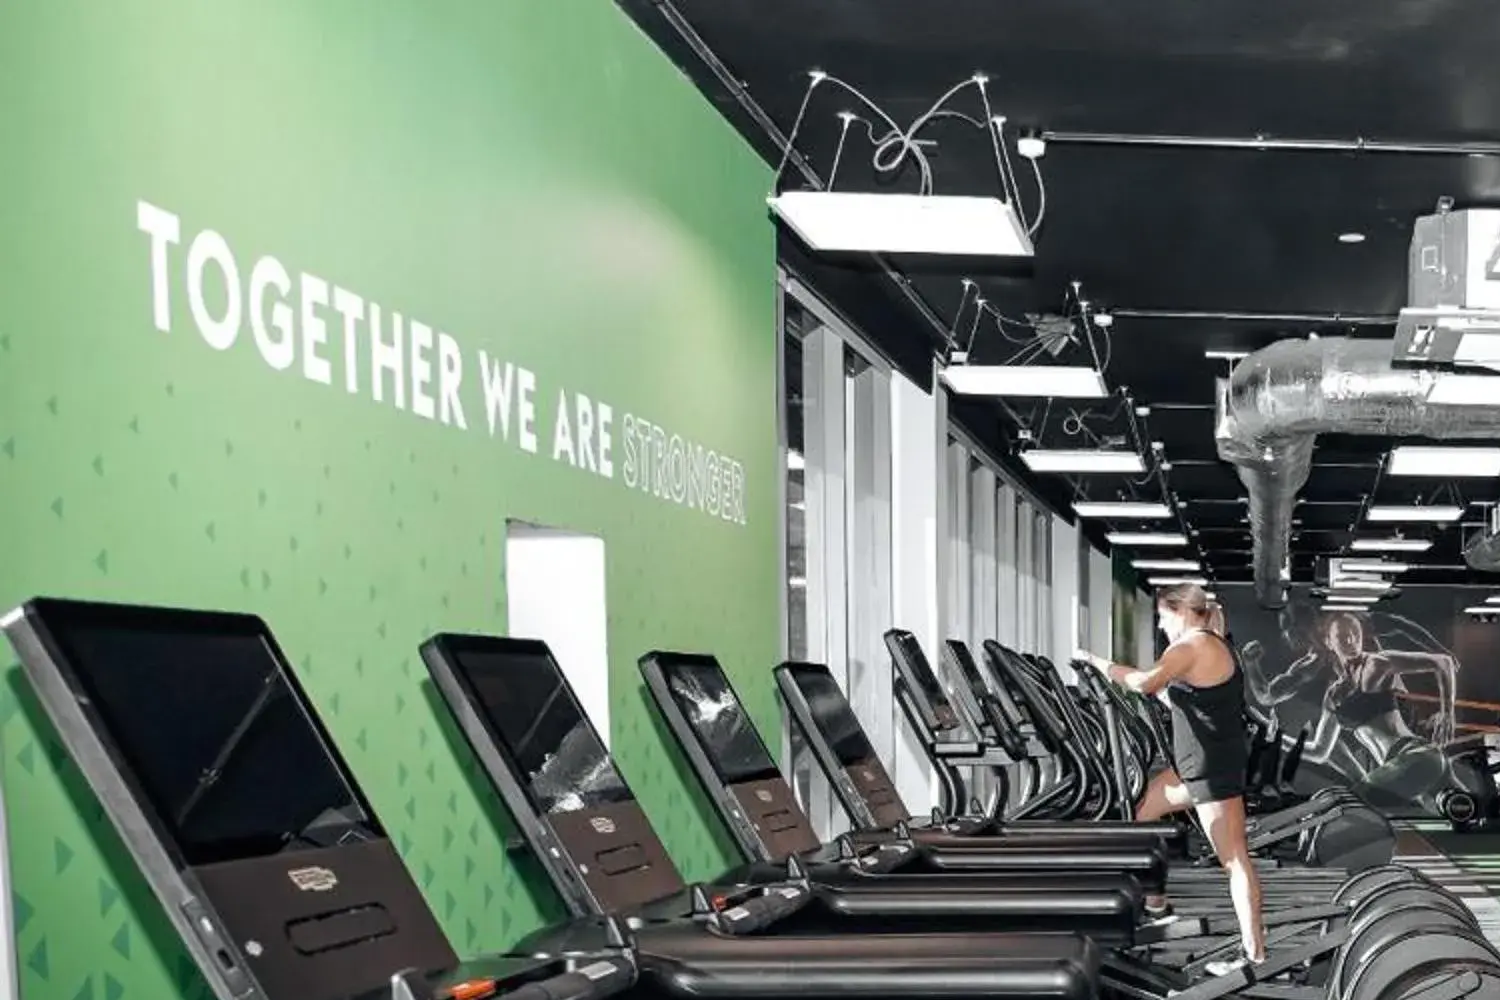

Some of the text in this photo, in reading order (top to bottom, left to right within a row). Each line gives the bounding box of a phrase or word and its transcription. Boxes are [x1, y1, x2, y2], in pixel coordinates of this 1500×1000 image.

[137, 200, 747, 525] TOGETHER WE ARE STRONGER
